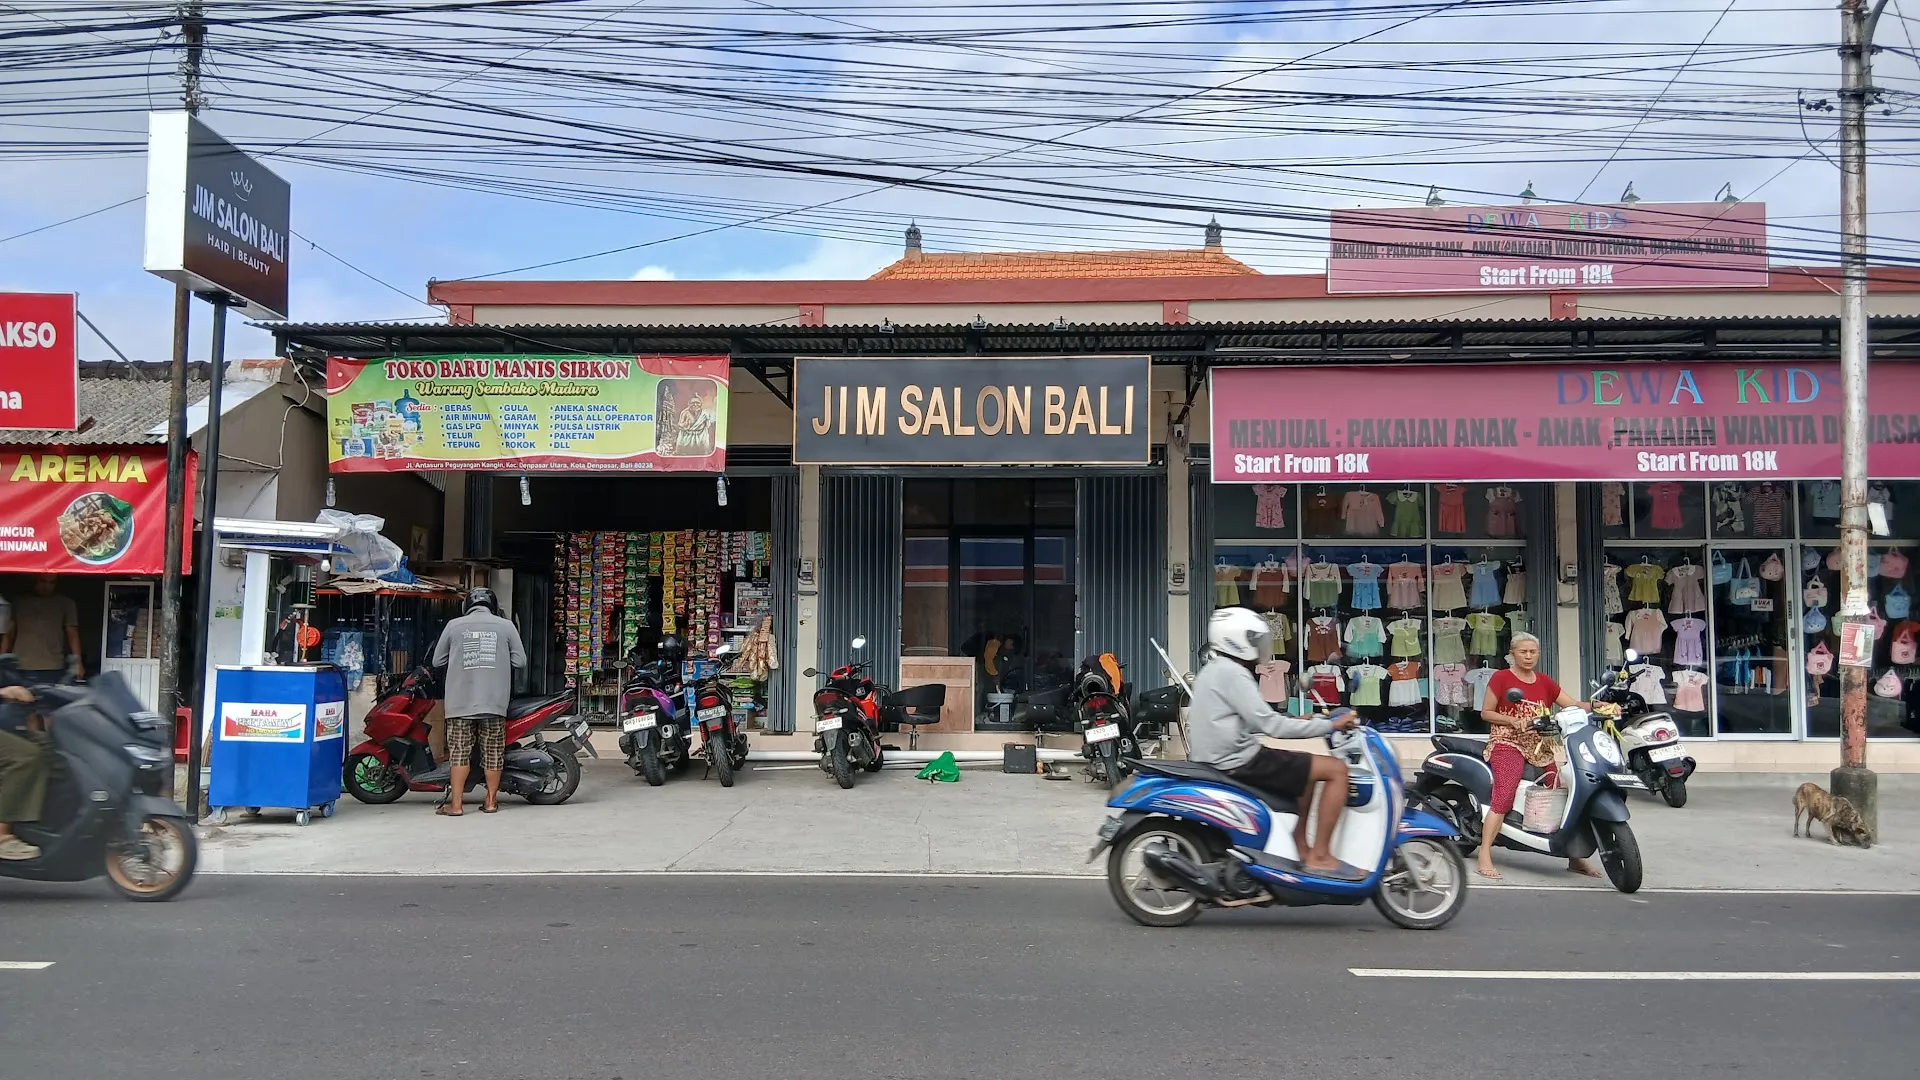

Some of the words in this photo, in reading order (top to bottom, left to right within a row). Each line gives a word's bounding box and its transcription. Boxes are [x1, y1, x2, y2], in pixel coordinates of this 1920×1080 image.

[193, 184, 214, 223] JIM
[216, 198, 259, 249] SALON
[260, 223, 284, 263] BALI
[1467, 212, 1541, 231] DEWA
[1568, 211, 1628, 231] KIDS
[207, 233, 229, 254] HAIR
[238, 250, 271, 276] BEAUTY
[1333, 242, 1378, 259] MENJUAL
[1386, 241, 1432, 258] PAKAIAN
[1556, 240, 1597, 256] WANITA
[1479, 266, 1526, 285] Start
[1530, 266, 1576, 285] From
[1580, 265, 1614, 285] 18K
[384, 359, 436, 380] TOKO
[439, 359, 490, 379] BARU
[494, 359, 556, 379] MANIS
[558, 359, 631, 379] SIBKON
[415, 381, 474, 399] Warung
[475, 380, 537, 398] Sembako
[538, 381, 600, 396] Madura
[1556, 368, 1705, 405] DEWA
[406, 401, 433, 412] Sedia
[444, 404, 472, 412] BERAS
[504, 404, 529, 412] GULA
[554, 404, 585, 412] ANEKA
[587, 404, 618, 412] SNACK
[811, 385, 887, 436] JIM
[898, 384, 1032, 437] SALON
[1043, 385, 1134, 436] BALI
[445, 413, 460, 421] AIR
[462, 413, 491, 421] MINUM
[504, 413, 537, 421] GARAM
[554, 413, 583, 421] PULSA
[586, 413, 602, 421] ALL
[605, 413, 653, 421] OPERATOR
[1229, 418, 1331, 449] MENJUAL
[1347, 417, 1449, 449] PAKAIAN
[1453, 417, 1518, 448] ANAK
[1537, 416, 1602, 448] ANAK
[1723, 414, 1818, 446] WANITA
[447, 441, 480, 449] TEPUNG
[505, 441, 536, 449] ROKOK
[553, 441, 570, 449] DLL
[10, 454, 148, 483] AREMA
[445, 462, 480, 470] Peguyangan
[519, 462, 548, 470] Denpasar
[587, 462, 619, 470] Denpasar,
[1234, 453, 1281, 474] Start
[1284, 453, 1331, 474] From
[1334, 453, 1369, 473] 18K
[1637, 451, 1686, 472] Start
[1689, 451, 1739, 472] From
[1742, 450, 1778, 472] 18K
[0, 526, 35, 538] INGUR
[250, 709, 278, 717] MAHA
